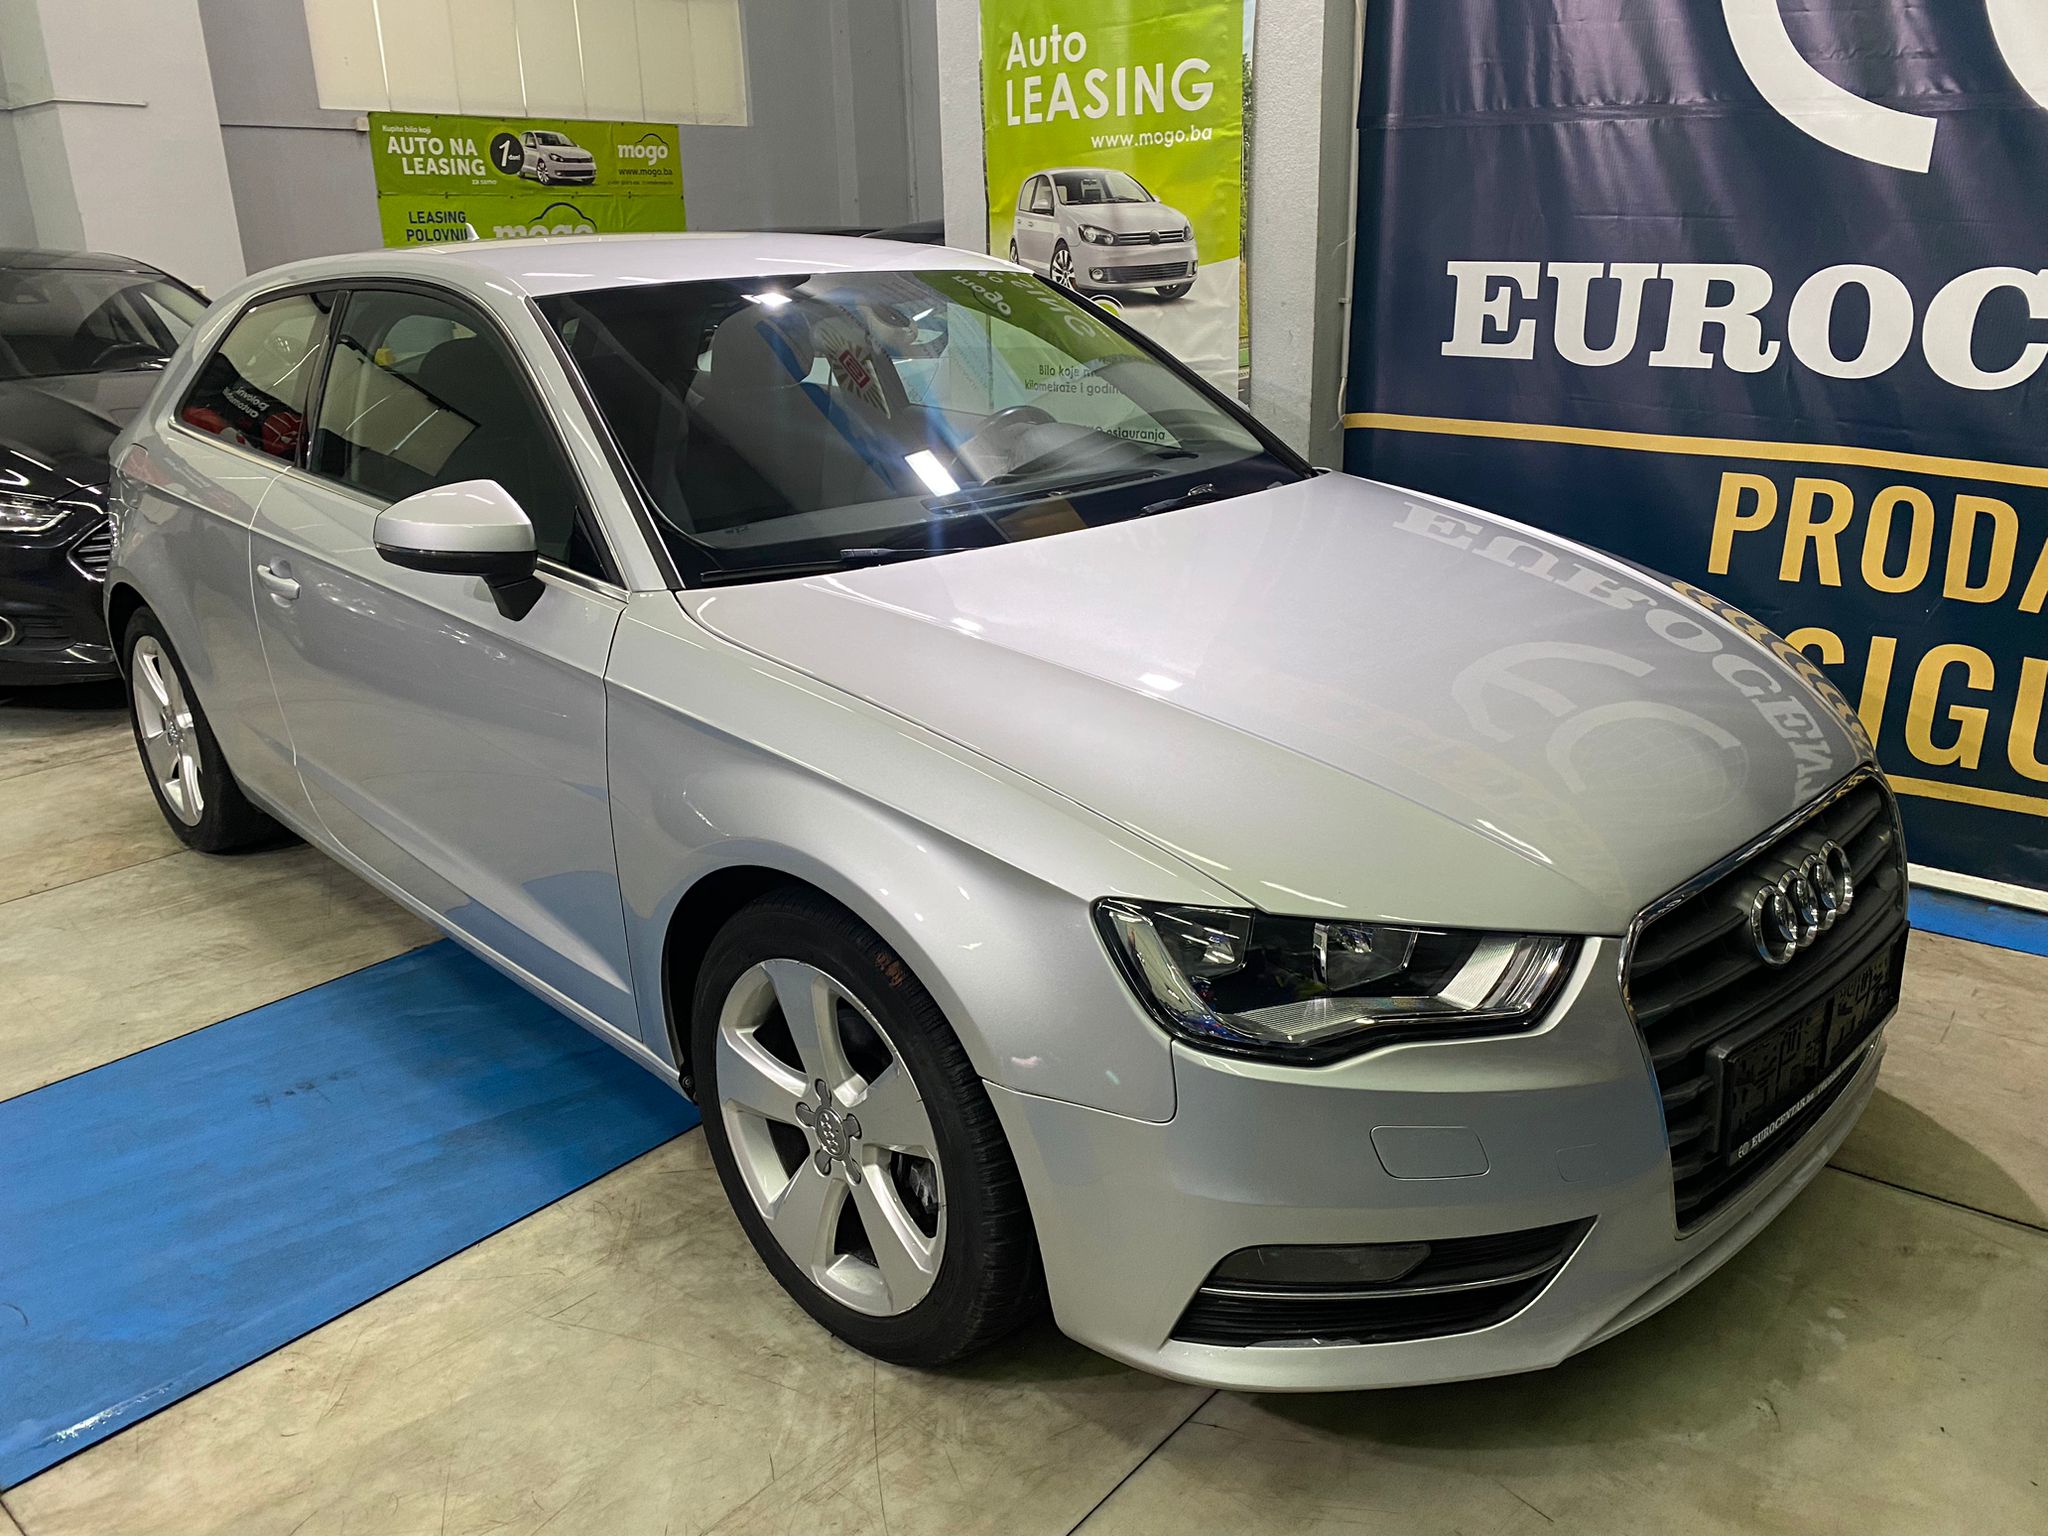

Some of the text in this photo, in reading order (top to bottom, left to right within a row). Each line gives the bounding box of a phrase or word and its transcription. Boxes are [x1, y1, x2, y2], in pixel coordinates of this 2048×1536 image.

[1005, 24, 1087, 71] Auto
[1006, 58, 1214, 126] LEASING
[387, 136, 478, 156] AUTO NA
[1091, 125, 1213, 149] www.mogo.ba
[617, 144, 669, 166] mogo
[402, 157, 486, 176] LEASING
[618, 167, 673, 178] www.mogo.ba
[408, 211, 467, 225] LEASING
[1441, 261, 2048, 391] EUROC
